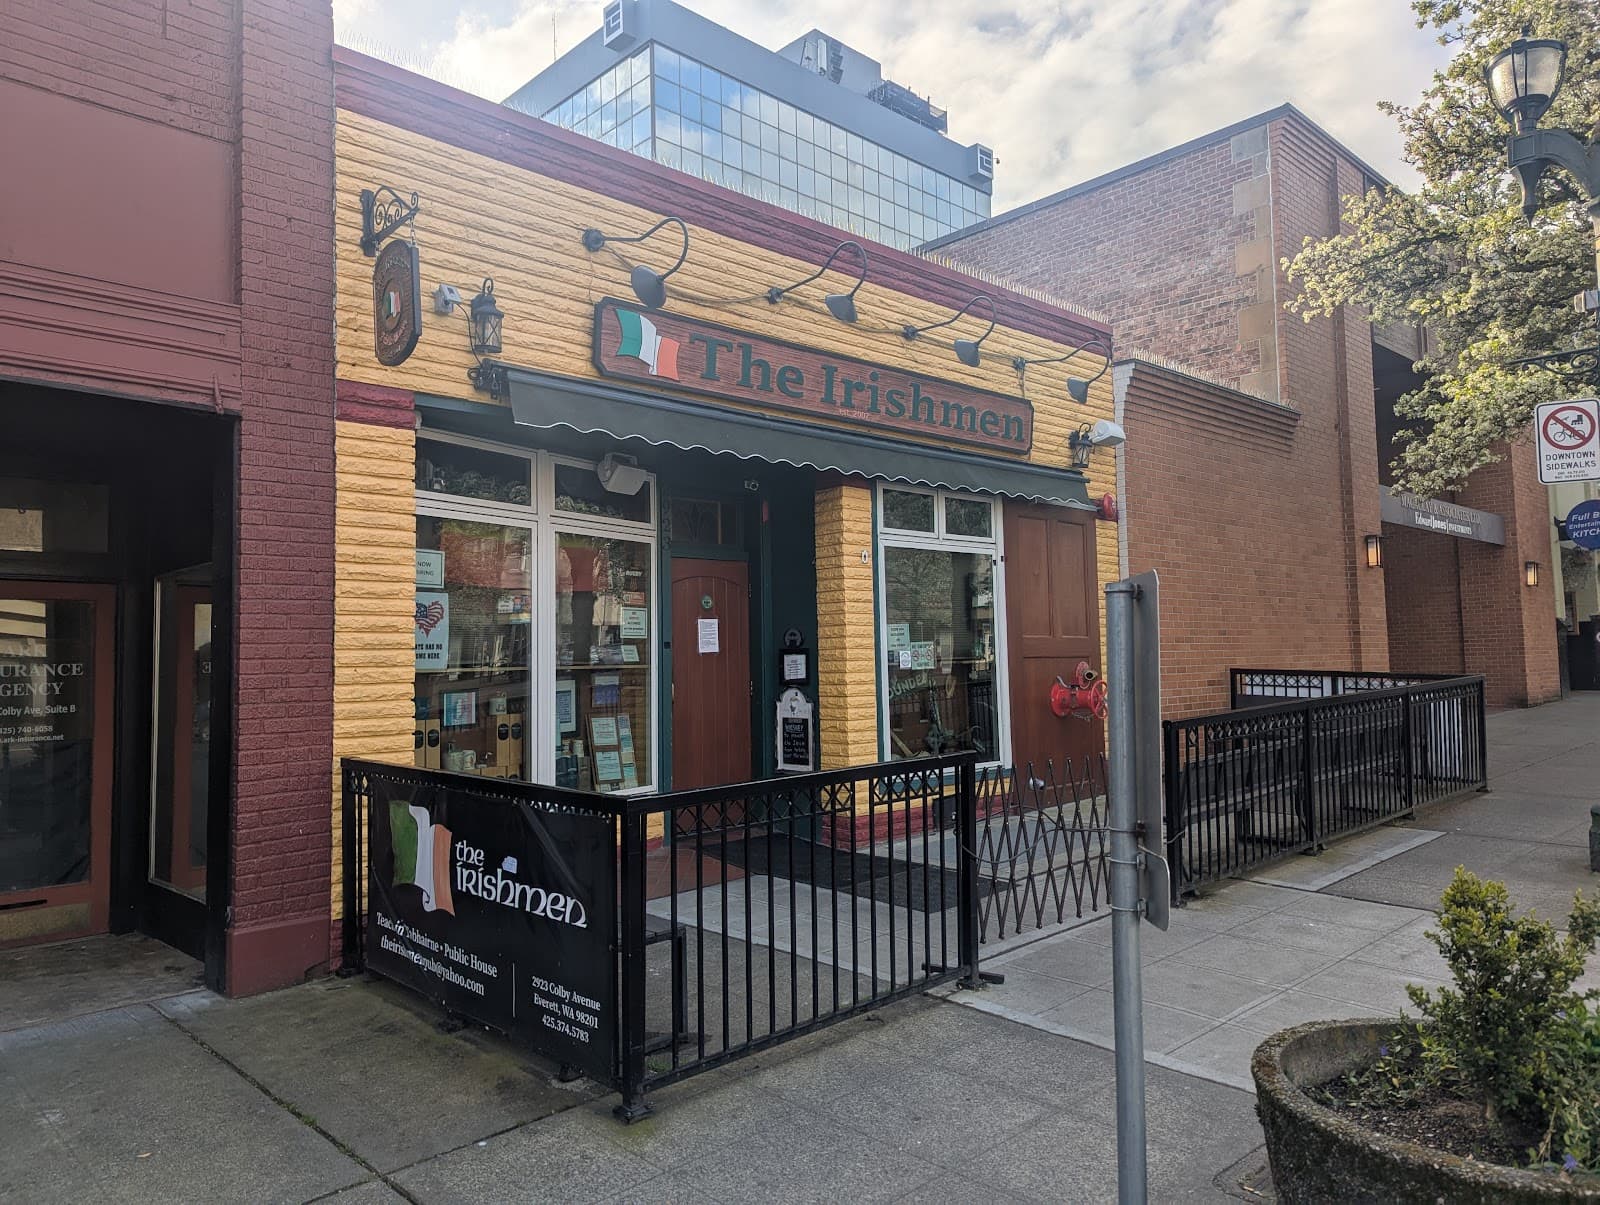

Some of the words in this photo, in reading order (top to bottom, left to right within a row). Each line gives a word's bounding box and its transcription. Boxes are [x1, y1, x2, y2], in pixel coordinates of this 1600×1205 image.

[689, 333, 805, 398] The
[819, 364, 1026, 443] Irishmen
[1545, 450, 1596, 462] DOWNTOWN
[1545, 460, 1597, 471] SIDEWALKS
[1571, 512, 1590, 522] Full
[45, 704, 68, 714] Suite
[455, 839, 485, 866] the
[444, 943, 470, 966] Public
[470, 953, 498, 978] House
[532, 976, 549, 992] 2923
[549, 982, 571, 1003] Colby
[572, 991, 601, 1011] Avenue
[533, 992, 561, 1016] Everett,
[561, 1004, 575, 1020] WA
[575, 1010, 599, 1029] 98201
[542, 1014, 590, 1043] 425.374.5783
